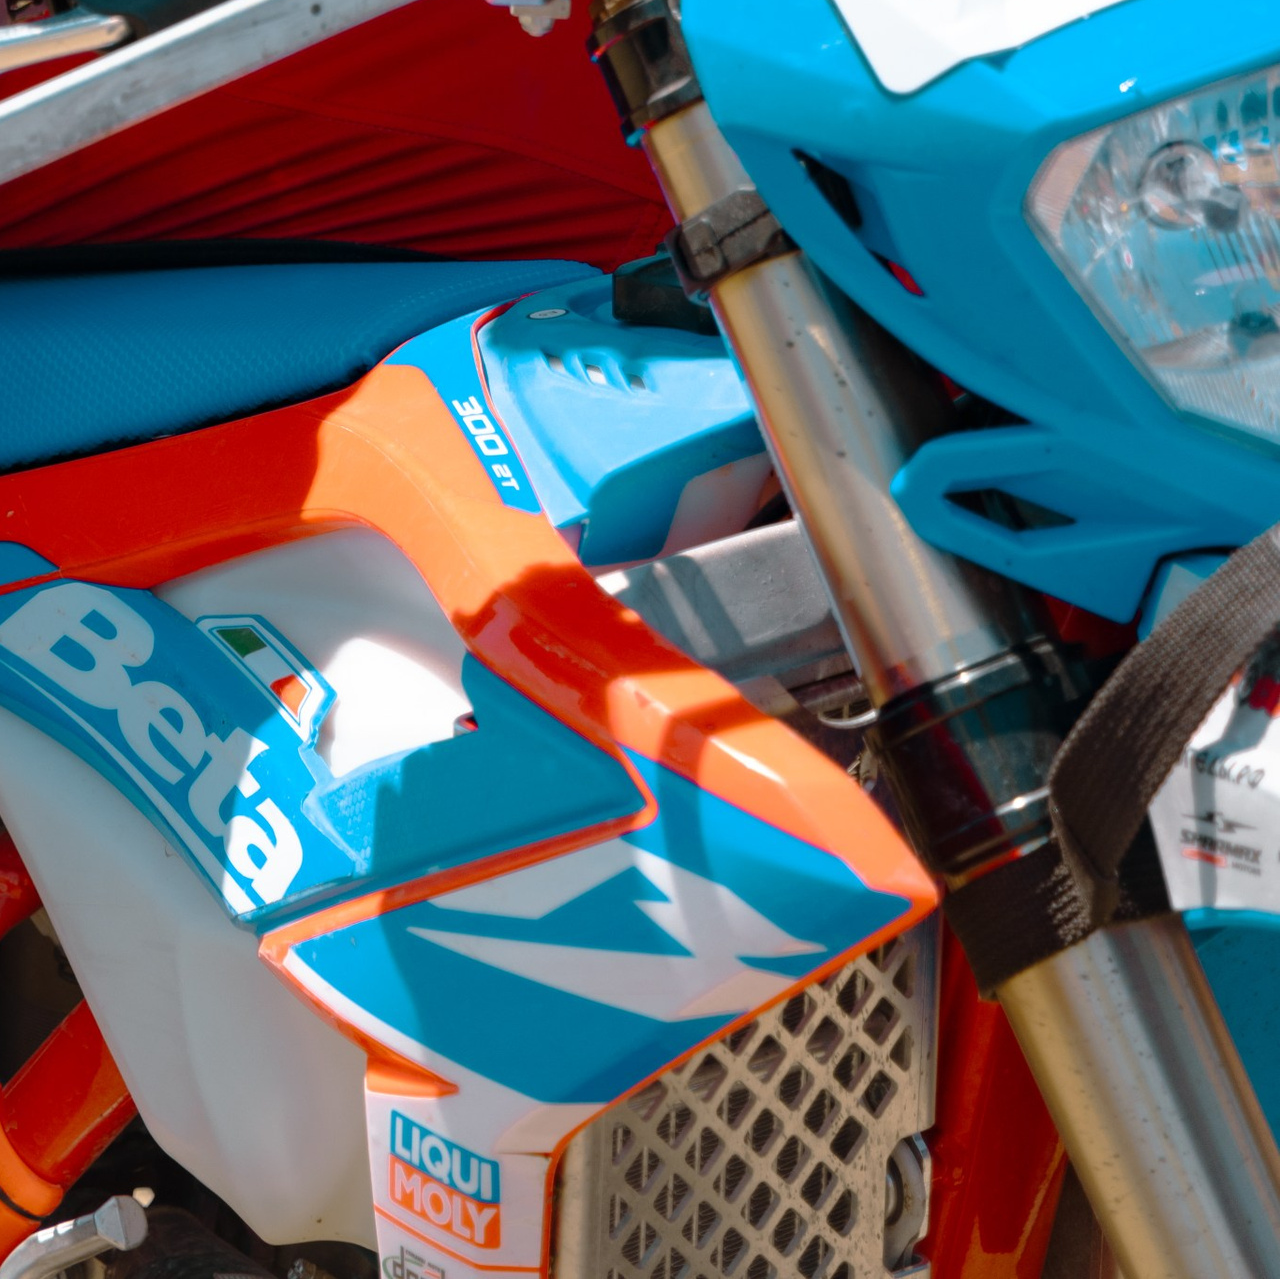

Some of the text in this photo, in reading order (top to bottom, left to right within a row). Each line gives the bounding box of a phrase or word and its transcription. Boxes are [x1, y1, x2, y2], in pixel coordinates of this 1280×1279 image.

[451, 395, 519, 491] 300 2T
[395, 1116, 493, 1201] LIQUI
[394, 1162, 498, 1245] MOLY
